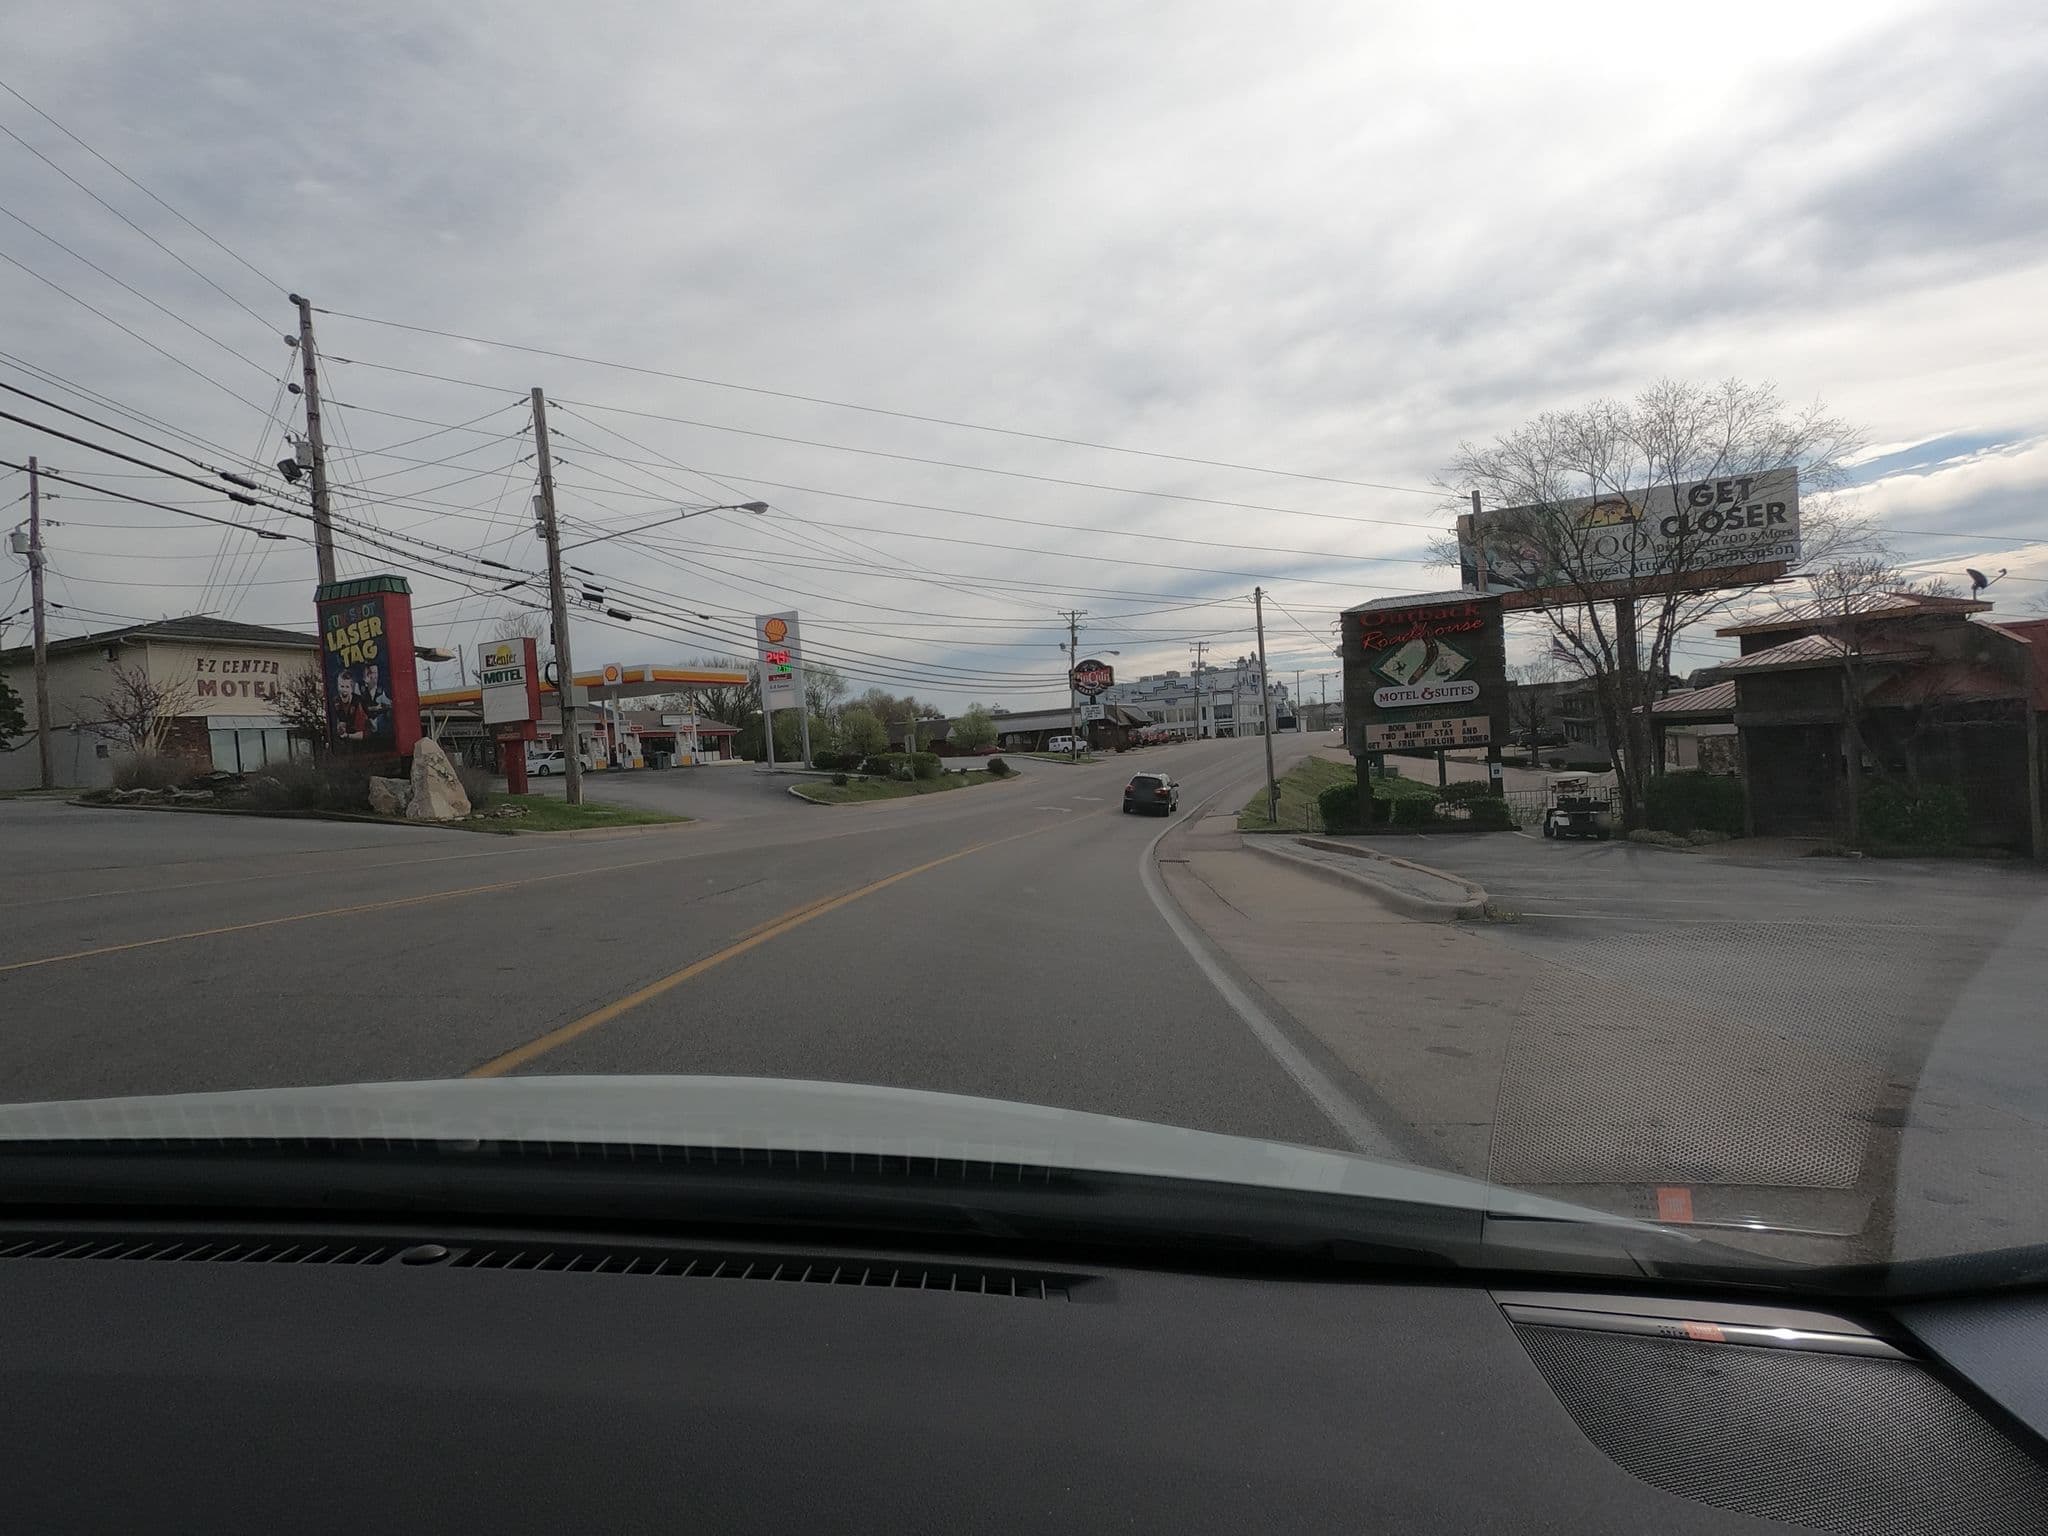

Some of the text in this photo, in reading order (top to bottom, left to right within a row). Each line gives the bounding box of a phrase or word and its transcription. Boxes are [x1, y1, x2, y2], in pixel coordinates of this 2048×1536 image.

[1688, 478, 1754, 507] GET
[1660, 502, 1787, 538] CLOSER
[1360, 602, 1481, 626] Outback
[326, 616, 383, 652] LASER
[340, 639, 378, 668] TAG
[196, 658, 279, 675] E-Z CENTER
[483, 669, 522, 685] MOTEL
[1379, 686, 1474, 702] MOTEL & SUITES
[1416, 722, 1433, 730] WITH
[1442, 720, 1452, 729] US
[1462, 719, 1467, 727] A
[1367, 734, 1488, 750] GET A FREE SIRLOIN DINNER
[1381, 727, 1478, 740] TWO NIGHT STAY AND
